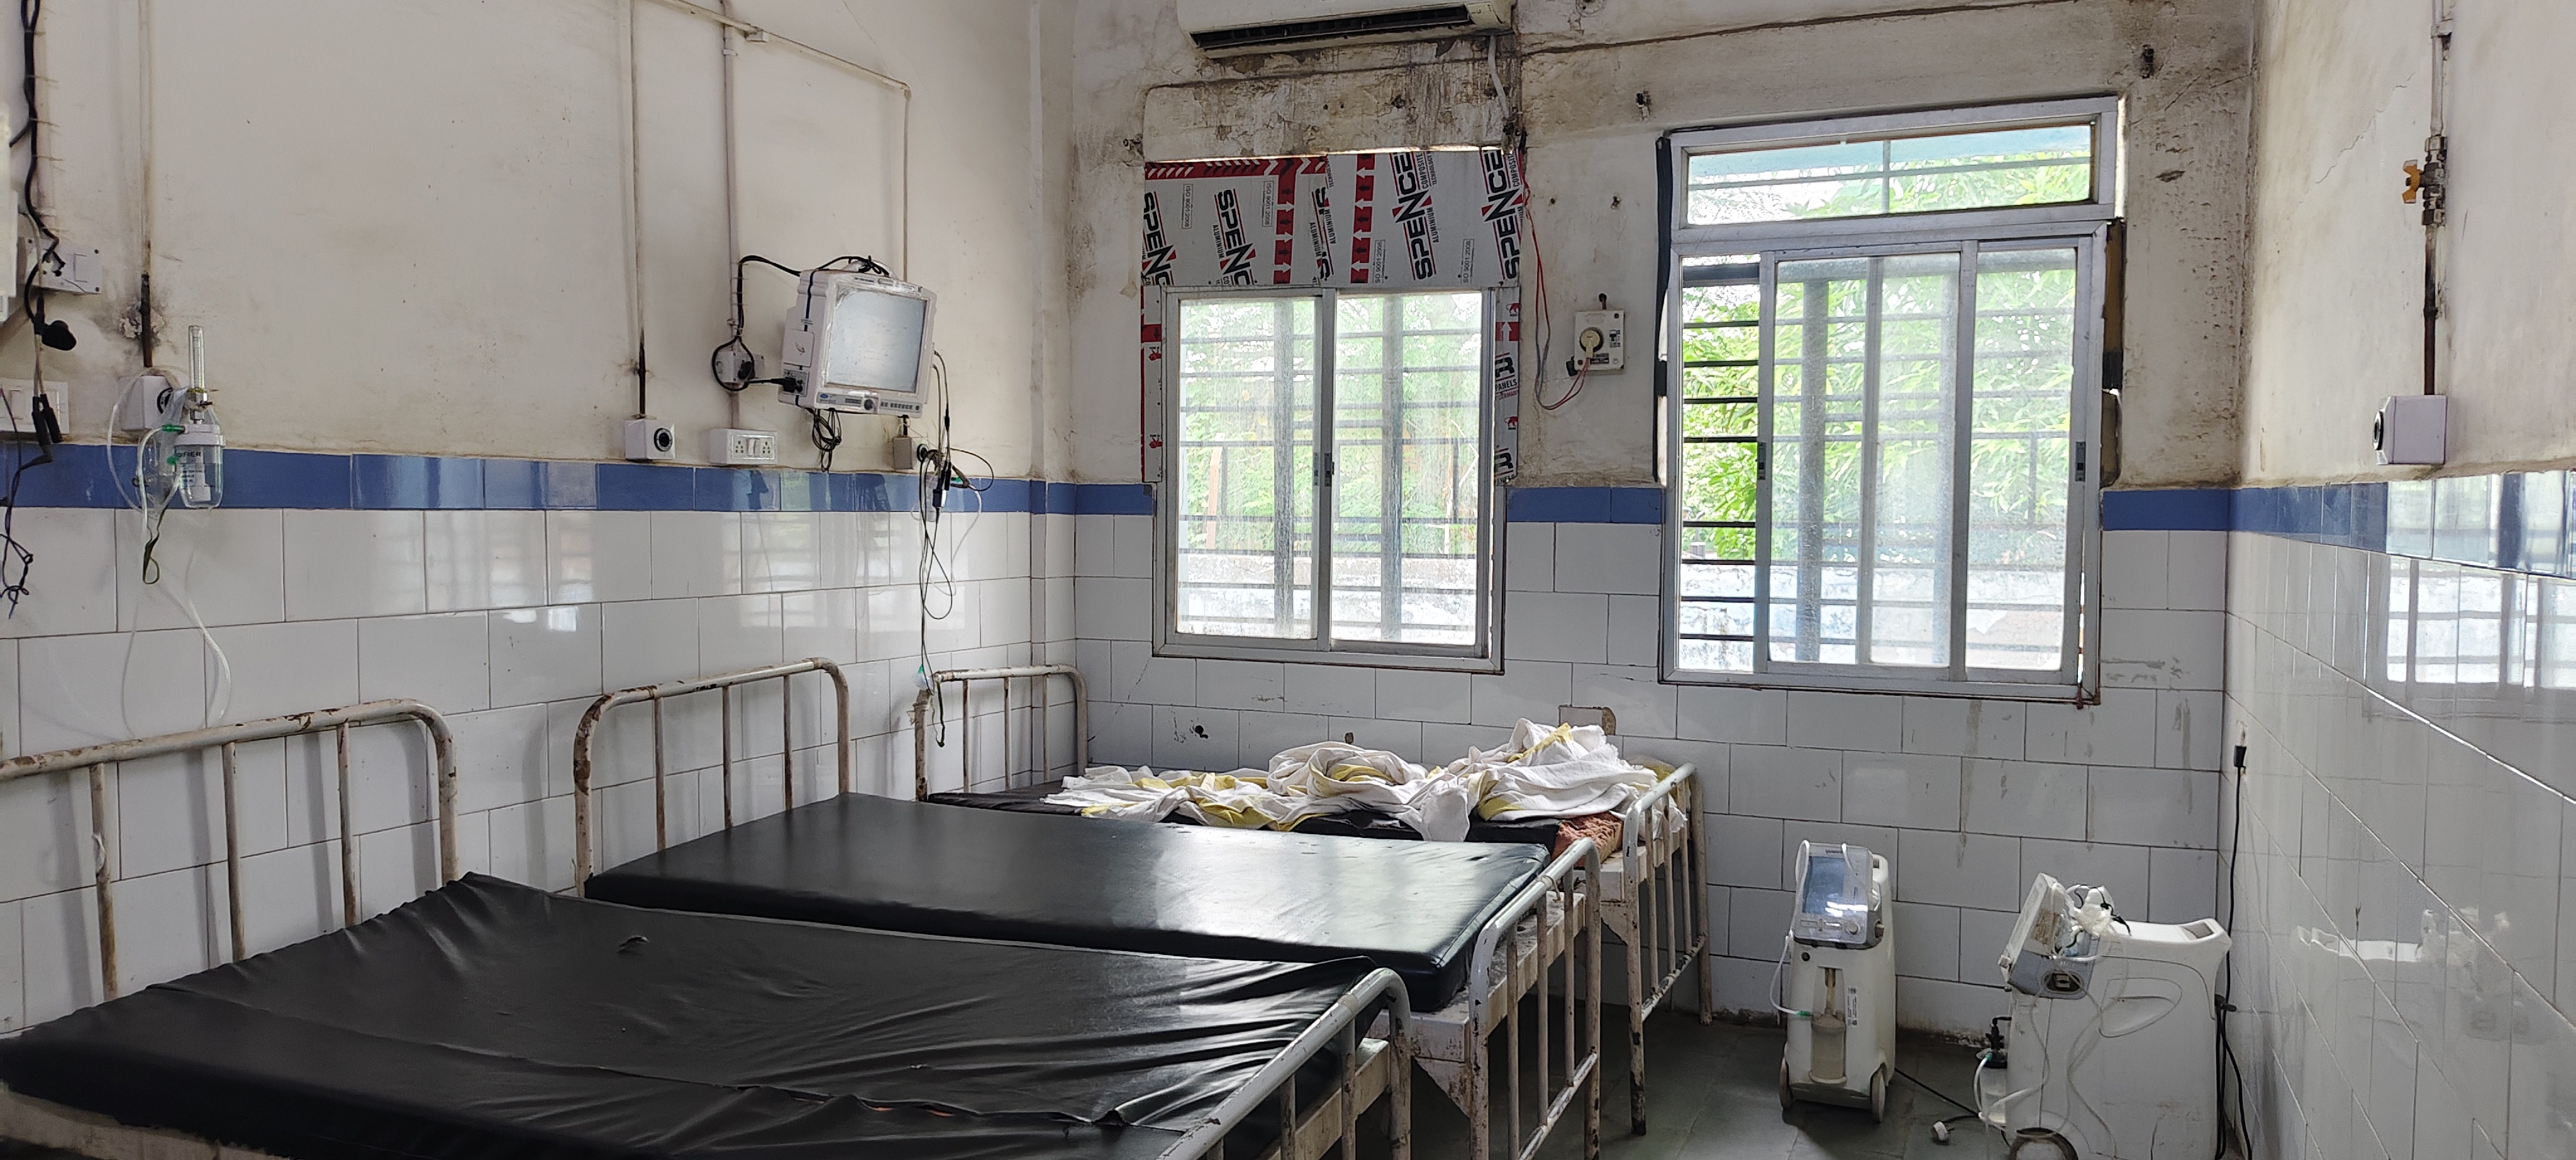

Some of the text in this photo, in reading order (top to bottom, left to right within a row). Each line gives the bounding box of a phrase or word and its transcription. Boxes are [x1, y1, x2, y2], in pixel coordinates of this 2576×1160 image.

[1415, 153, 1429, 189] COMPOSITE
[1393, 152, 1433, 280] SPENCE
[1426, 207, 1439, 243] ALUMINIUM
[1484, 149, 1520, 279] SPENCE
[1213, 225, 1225, 259] ALUMINIUM
[1309, 222, 1321, 257] ALUMINIUM
[1495, 379, 1517, 391] PANELS
